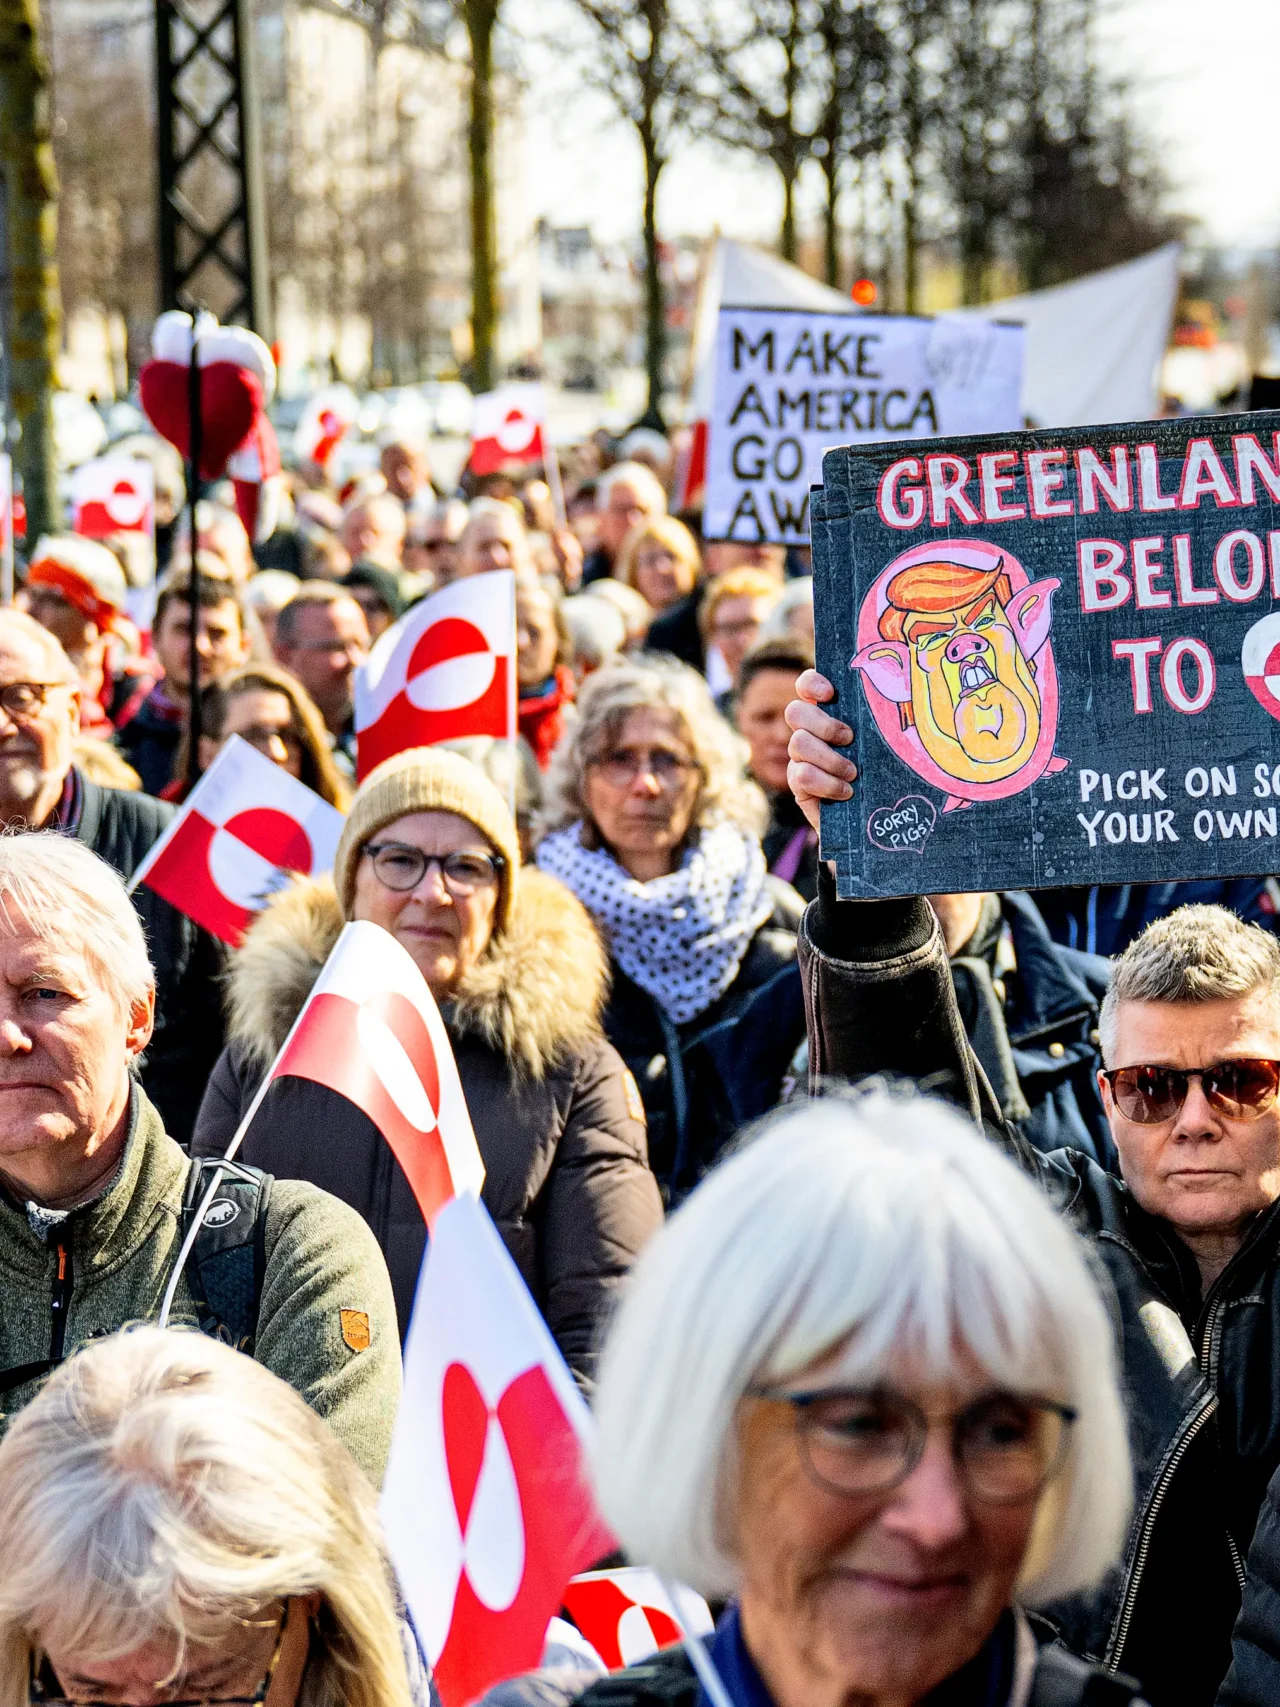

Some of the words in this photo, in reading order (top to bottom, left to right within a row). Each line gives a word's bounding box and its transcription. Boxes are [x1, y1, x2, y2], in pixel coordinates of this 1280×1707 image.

[730, 326, 883, 378] MAKE
[728, 381, 938, 434] AMERICA
[731, 433, 804, 482] GO
[1111, 636, 1217, 714] TO
[1079, 767, 1168, 803] PICK
[1184, 765, 1237, 798] ON
[873, 803, 919, 837] SORRY
[889, 816, 935, 849] PIGS!
[1076, 809, 1180, 848] YOUR
[1193, 806, 1279, 842] OWN
